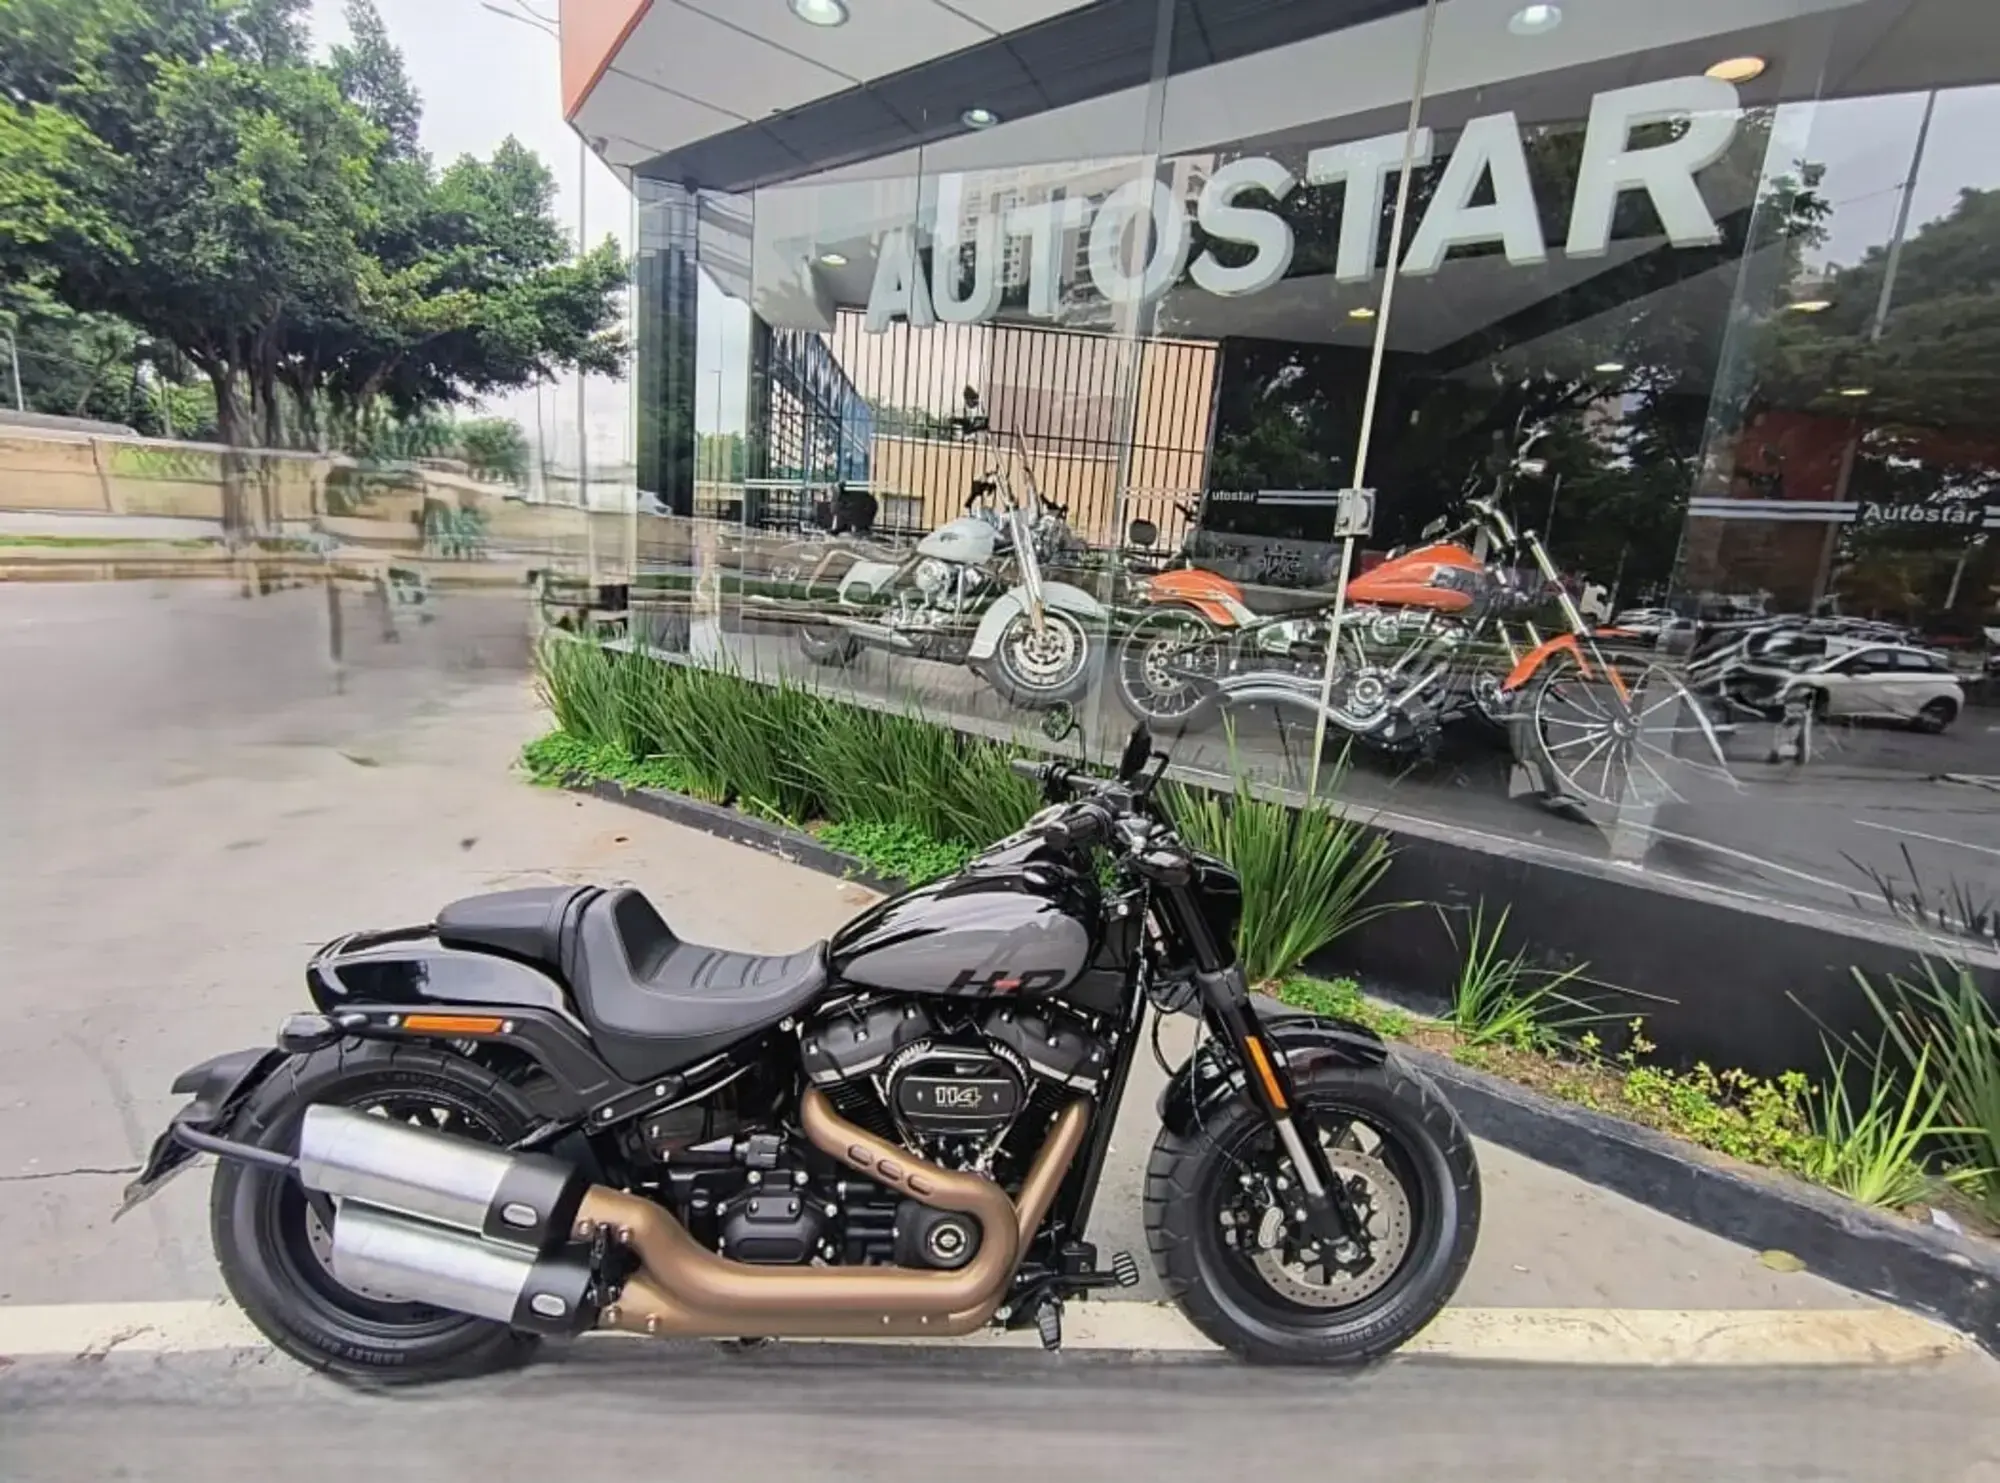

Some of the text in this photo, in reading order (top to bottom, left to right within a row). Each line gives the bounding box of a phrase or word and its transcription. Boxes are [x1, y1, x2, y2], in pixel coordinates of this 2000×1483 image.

[864, 75, 1741, 334] AUTOSTAR
[1863, 501, 1981, 523] Autostar
[935, 1086, 982, 1106] 114
